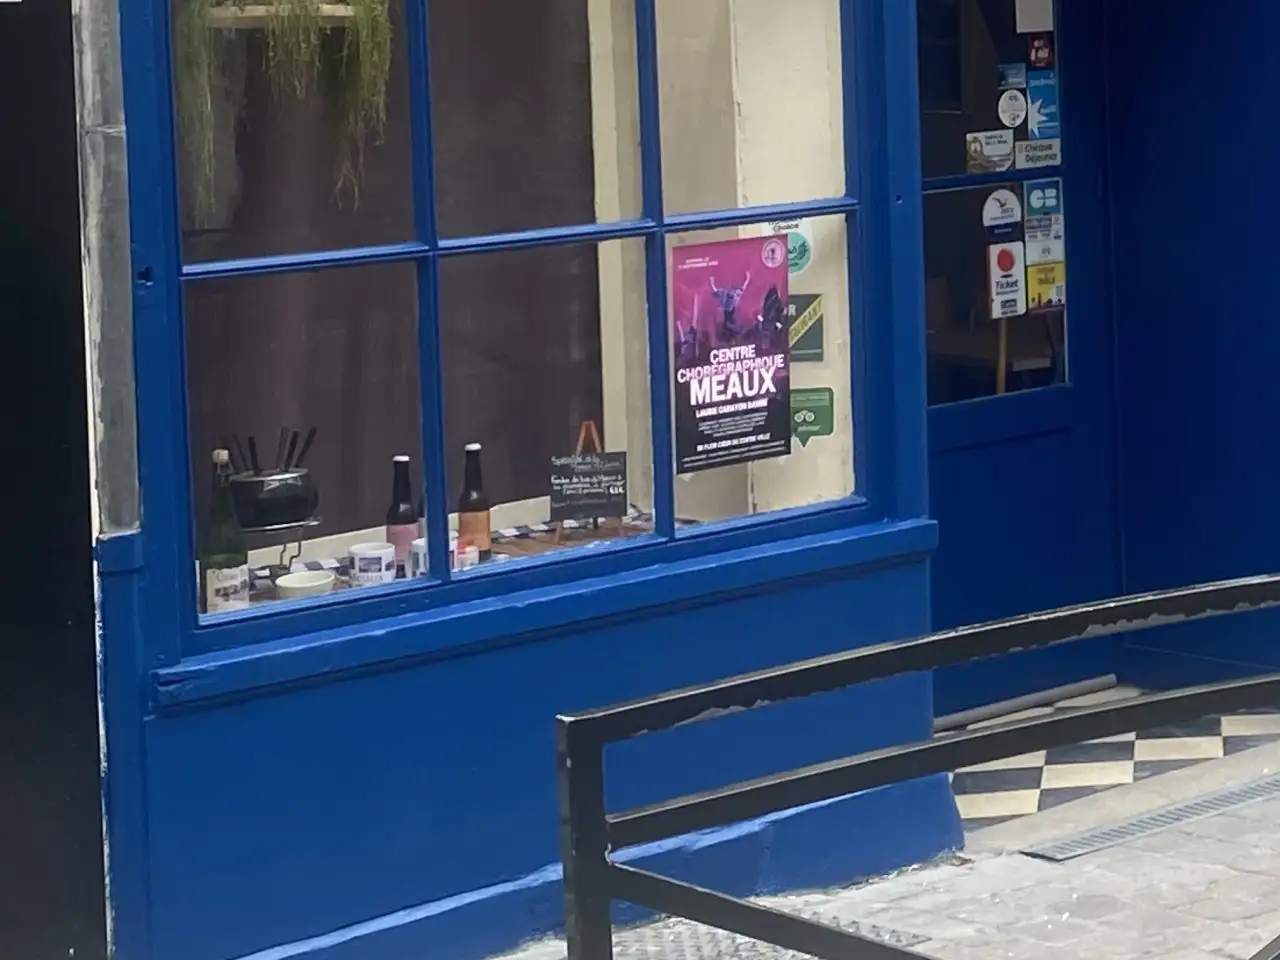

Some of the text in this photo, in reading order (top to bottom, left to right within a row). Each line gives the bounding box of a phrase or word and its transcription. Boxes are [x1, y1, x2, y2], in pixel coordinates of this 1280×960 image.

[995, 279, 1019, 289] Ticket
[710, 344, 755, 364] CENTRE
[690, 366, 776, 406] MEAUX
